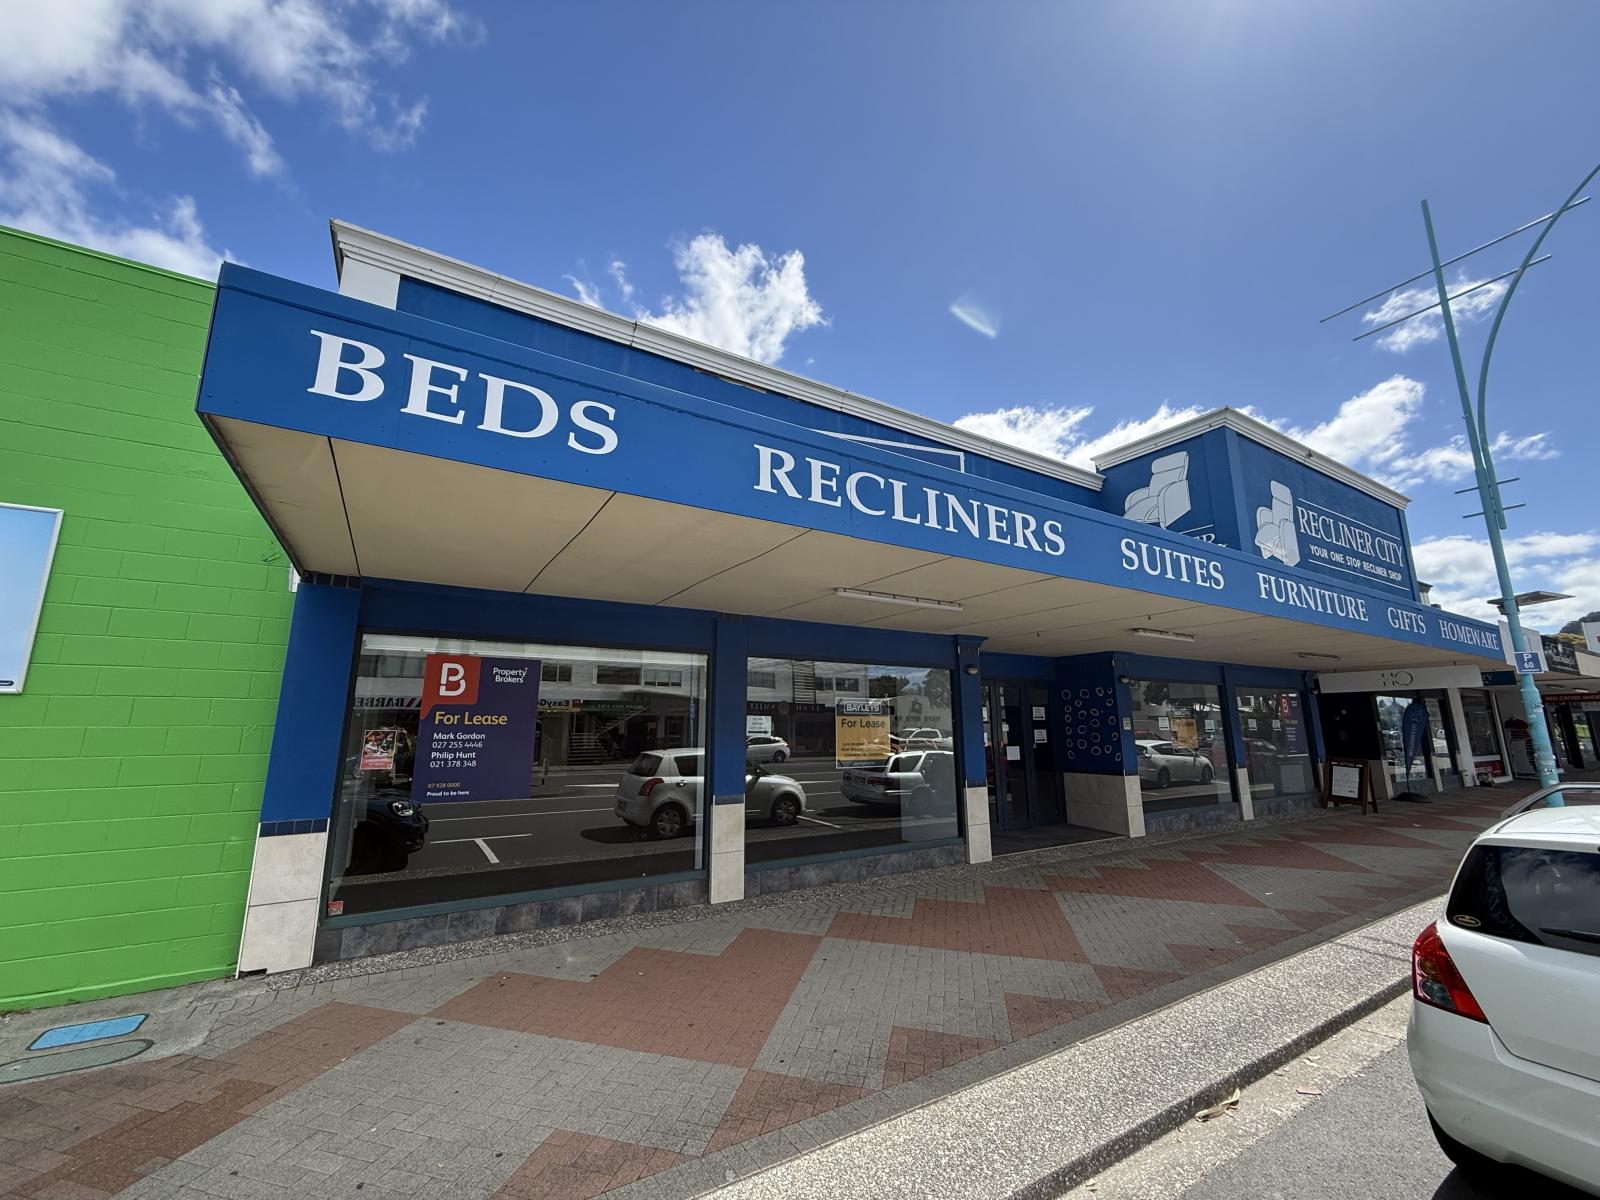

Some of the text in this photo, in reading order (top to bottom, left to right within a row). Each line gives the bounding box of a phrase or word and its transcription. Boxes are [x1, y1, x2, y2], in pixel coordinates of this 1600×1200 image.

[307, 329, 1500, 651] BEDS RECLINERS SUITES FURNITURE GIFTS HOMEWARE
[1296, 506, 1404, 567] RECLINER CITY
[1310, 544, 1402, 581] YOUR ONE STOP RECLINER SHOP
[1522, 653, 1532, 662] P
[493, 667, 528, 678] Property
[495, 675, 524, 683] Brokers
[846, 703, 880, 712] BAYLEYS
[434, 711, 508, 725] For Lease
[841, 718, 886, 728] For Lease
[433, 732, 486, 740] Mark Gordon
[432, 741, 447, 749] 027
[431, 751, 454, 761] Philip
[430, 760, 444, 768] 021
[446, 760, 461, 768] 378
